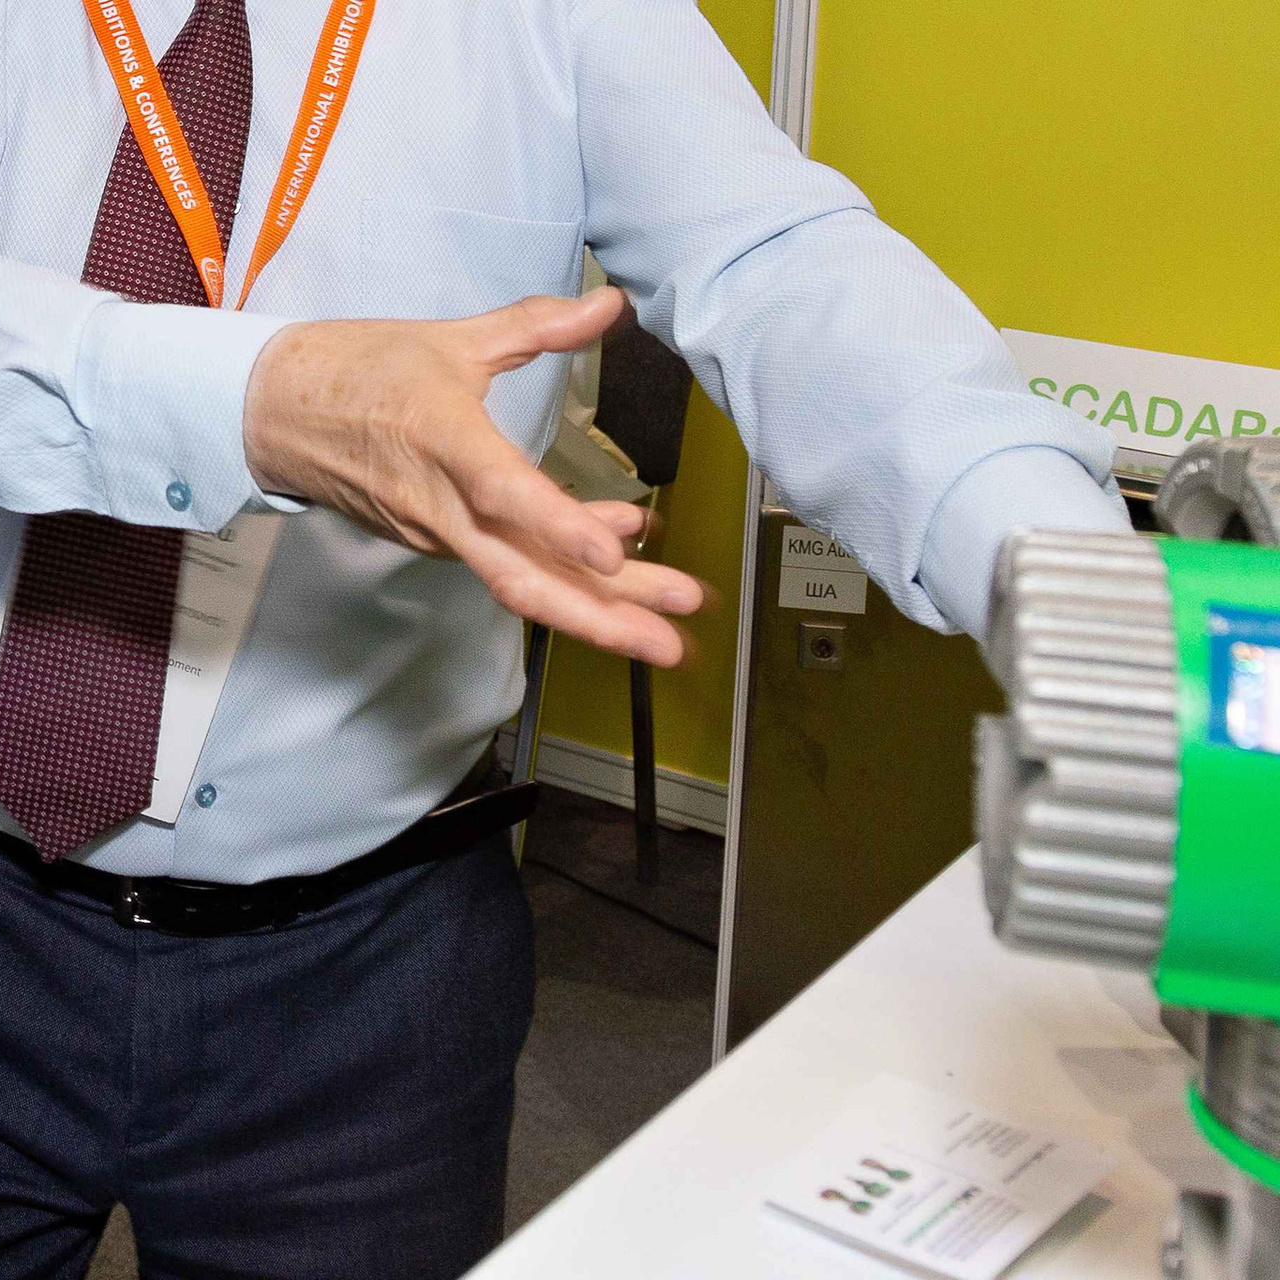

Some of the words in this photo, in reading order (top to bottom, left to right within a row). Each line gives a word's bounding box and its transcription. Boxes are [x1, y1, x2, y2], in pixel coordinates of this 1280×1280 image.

[128, 75, 145, 90] &
[135, 91, 198, 211] CONFERENCES
[275, 91, 335, 229] INTERNATIONAL
[788, 539, 824, 556] KMG
[805, 582, 838, 600] ША
